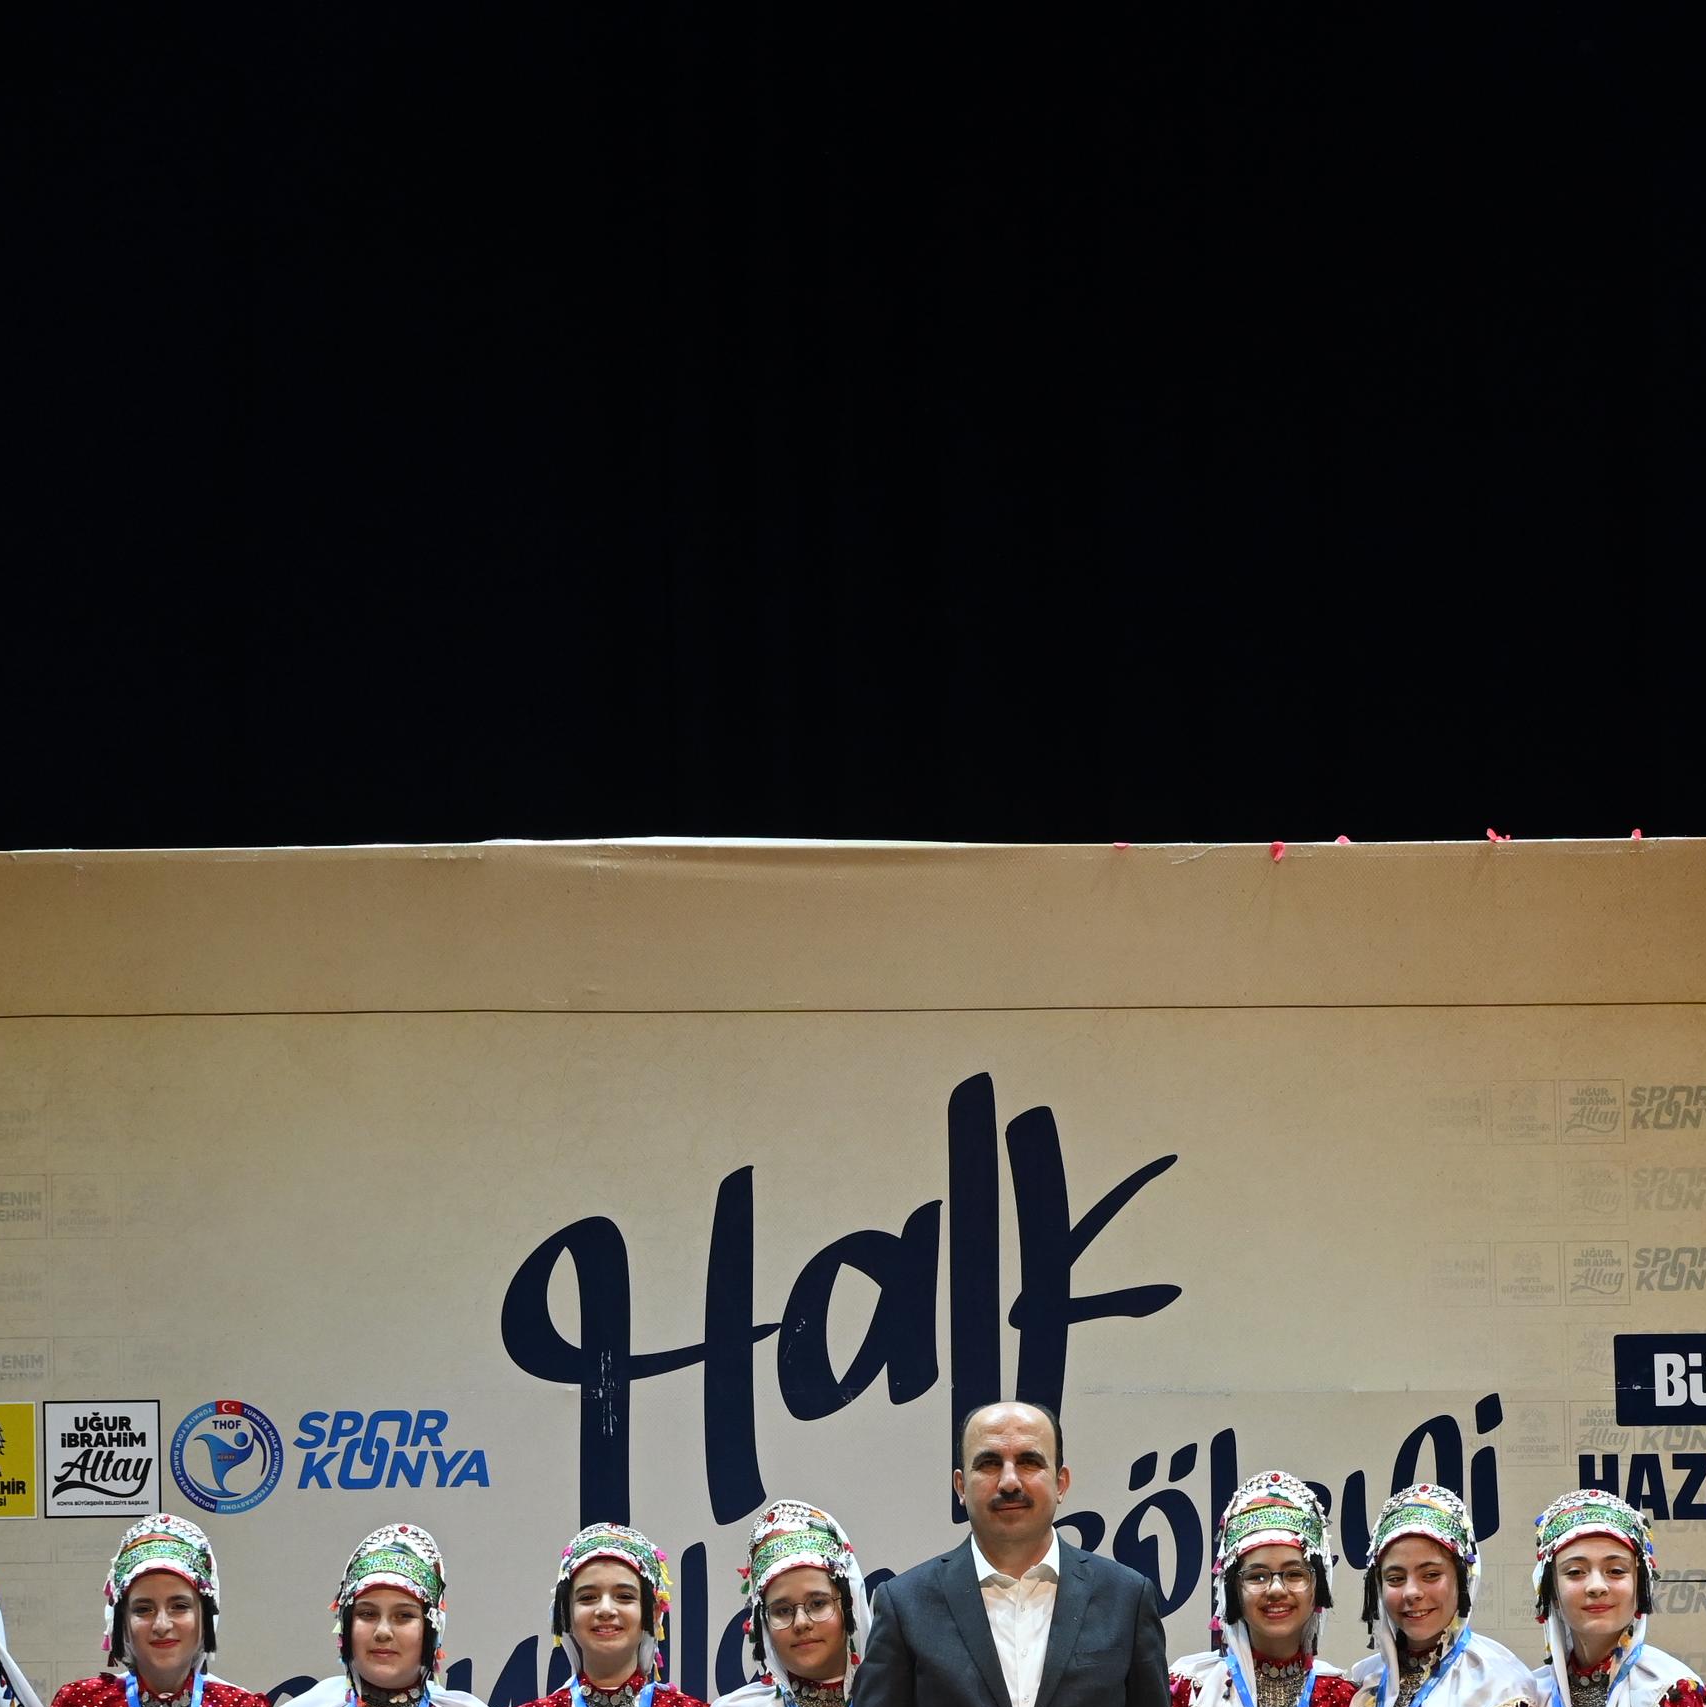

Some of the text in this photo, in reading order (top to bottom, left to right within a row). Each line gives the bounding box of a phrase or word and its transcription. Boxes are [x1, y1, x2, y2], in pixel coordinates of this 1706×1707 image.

[1564, 1105, 1621, 1133] Altay
[1569, 1267, 1625, 1295] Altay
[501, 1073, 1181, 1530] Halk
[74, 1413, 132, 1431] UĞUR
[212, 1420, 242, 1429] THOF
[293, 1410, 449, 1460] SPOR
[61, 1431, 146, 1448] İBRAHİM
[174, 1428, 187, 1448] FOLK
[266, 1428, 280, 1449] HALK
[52, 1449, 154, 1499] Altay
[173, 1449, 182, 1477] DANCE
[297, 1438, 489, 1489] KONYA
[177, 1475, 216, 1510] FEDERATION
